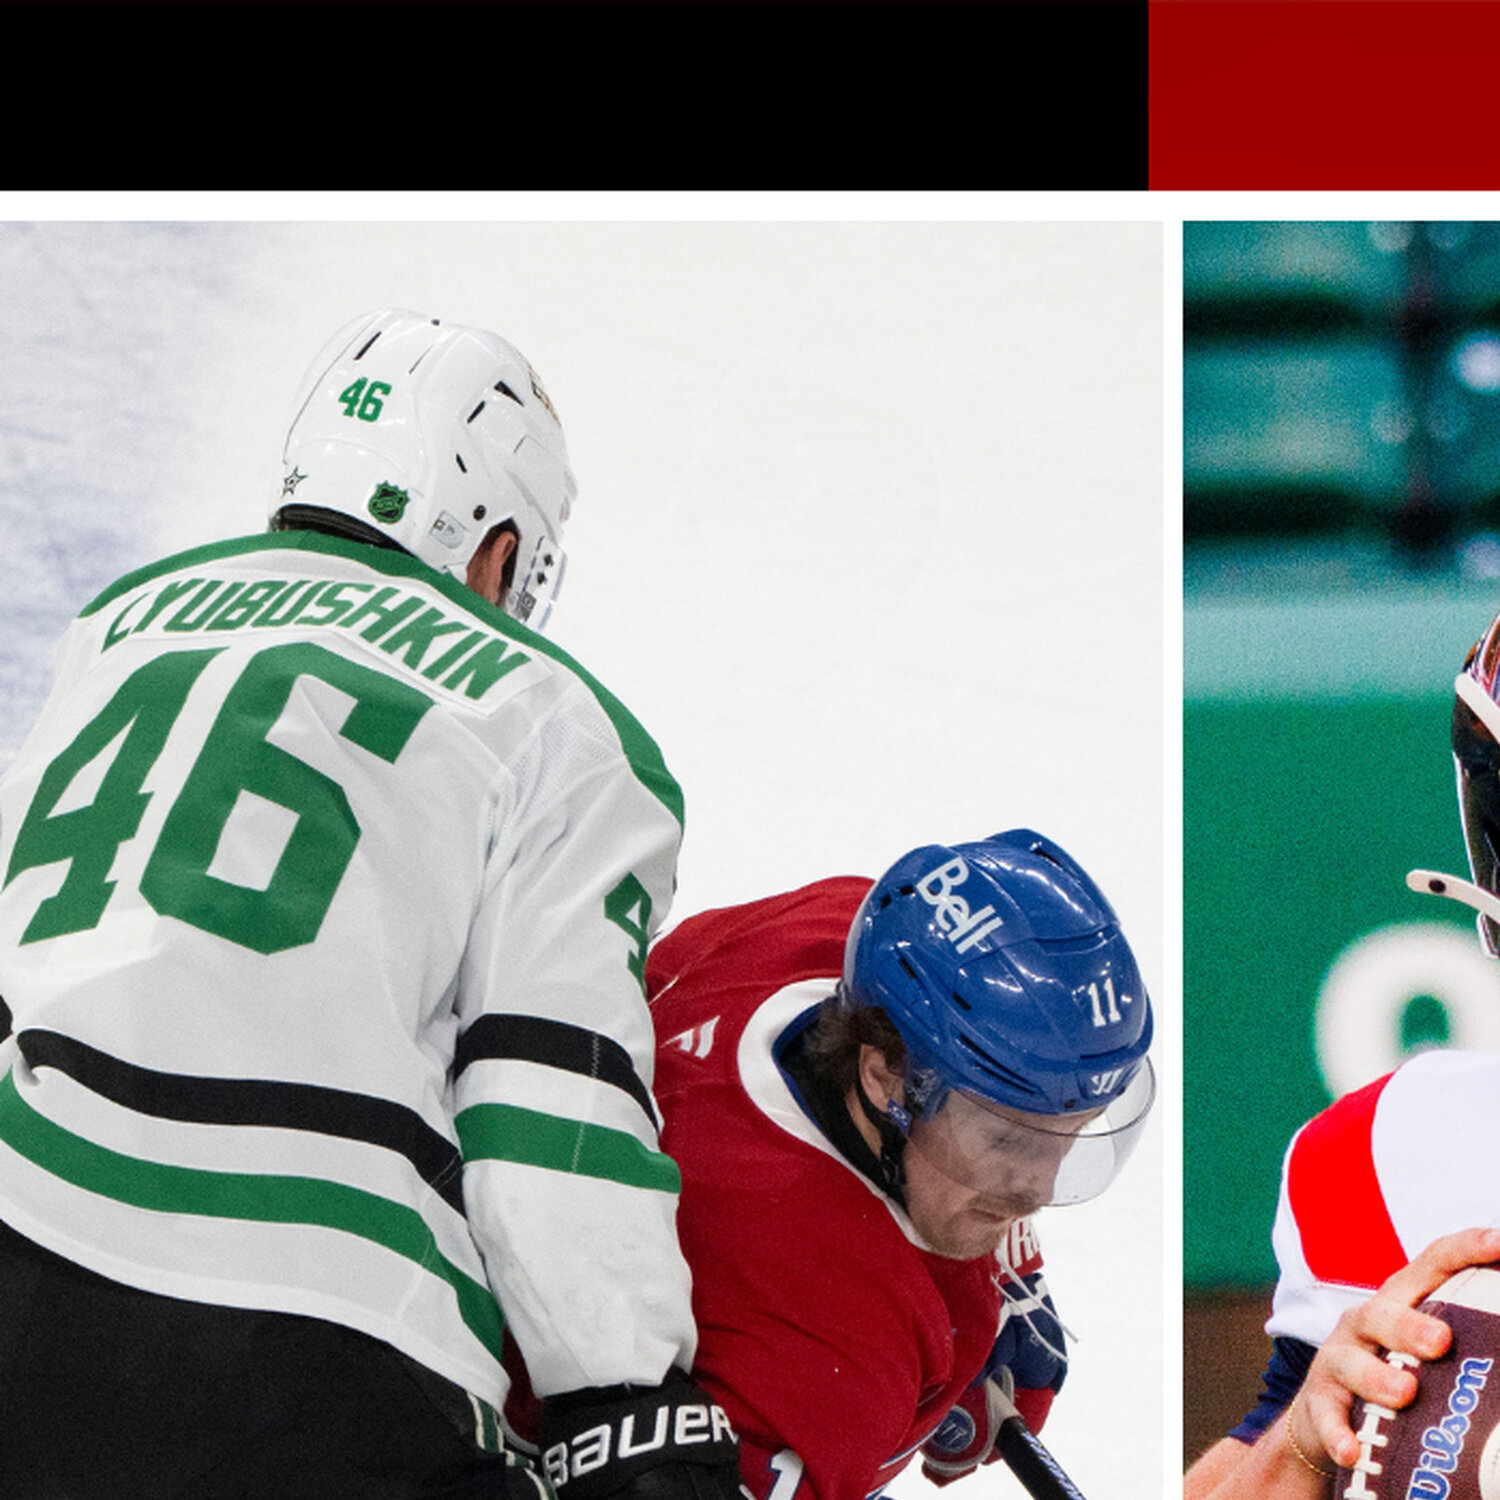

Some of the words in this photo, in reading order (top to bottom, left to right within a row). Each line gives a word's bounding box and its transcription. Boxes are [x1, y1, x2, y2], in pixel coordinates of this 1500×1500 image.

[338, 376, 392, 422] 46
[2, 641, 442, 956] 46
[917, 856, 1004, 955] Bell
[1087, 977, 1122, 1027] 11
